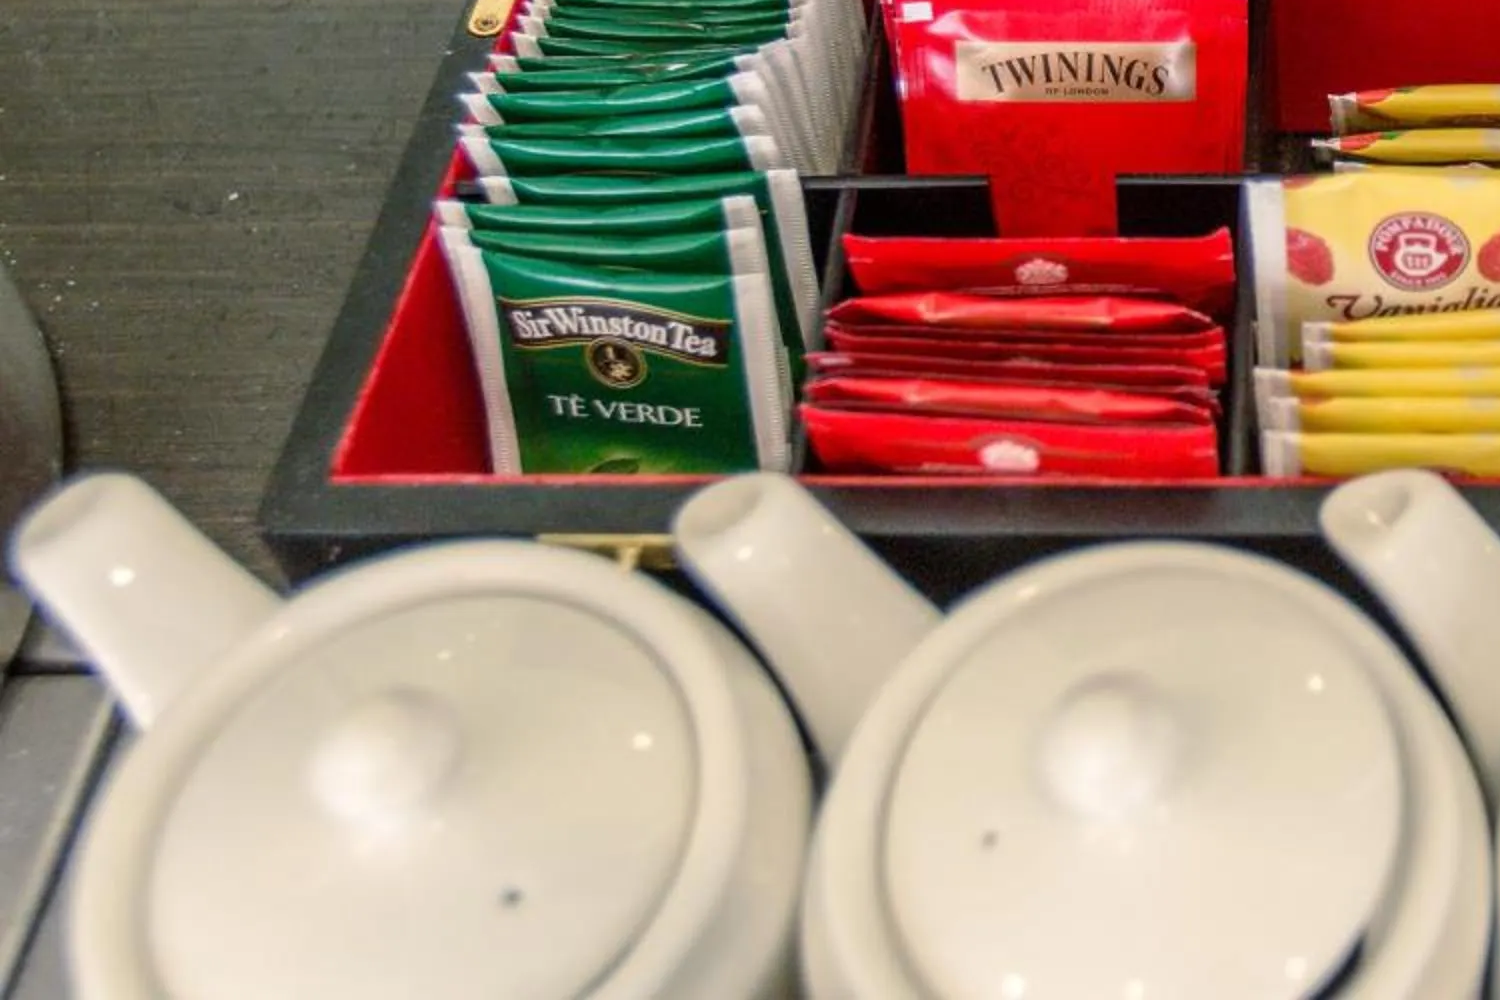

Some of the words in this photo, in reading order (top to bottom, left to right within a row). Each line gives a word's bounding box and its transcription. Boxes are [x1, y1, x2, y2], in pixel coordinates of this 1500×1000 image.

[981, 50, 1170, 96] TWININGS
[1063, 87, 1110, 97] LONDON
[1375, 215, 1465, 256] POMPADOUR
[511, 310, 553, 338] Sir
[544, 307, 667, 346] Winston
[664, 321, 718, 356] Tea
[592, 399, 704, 428] VERDE
